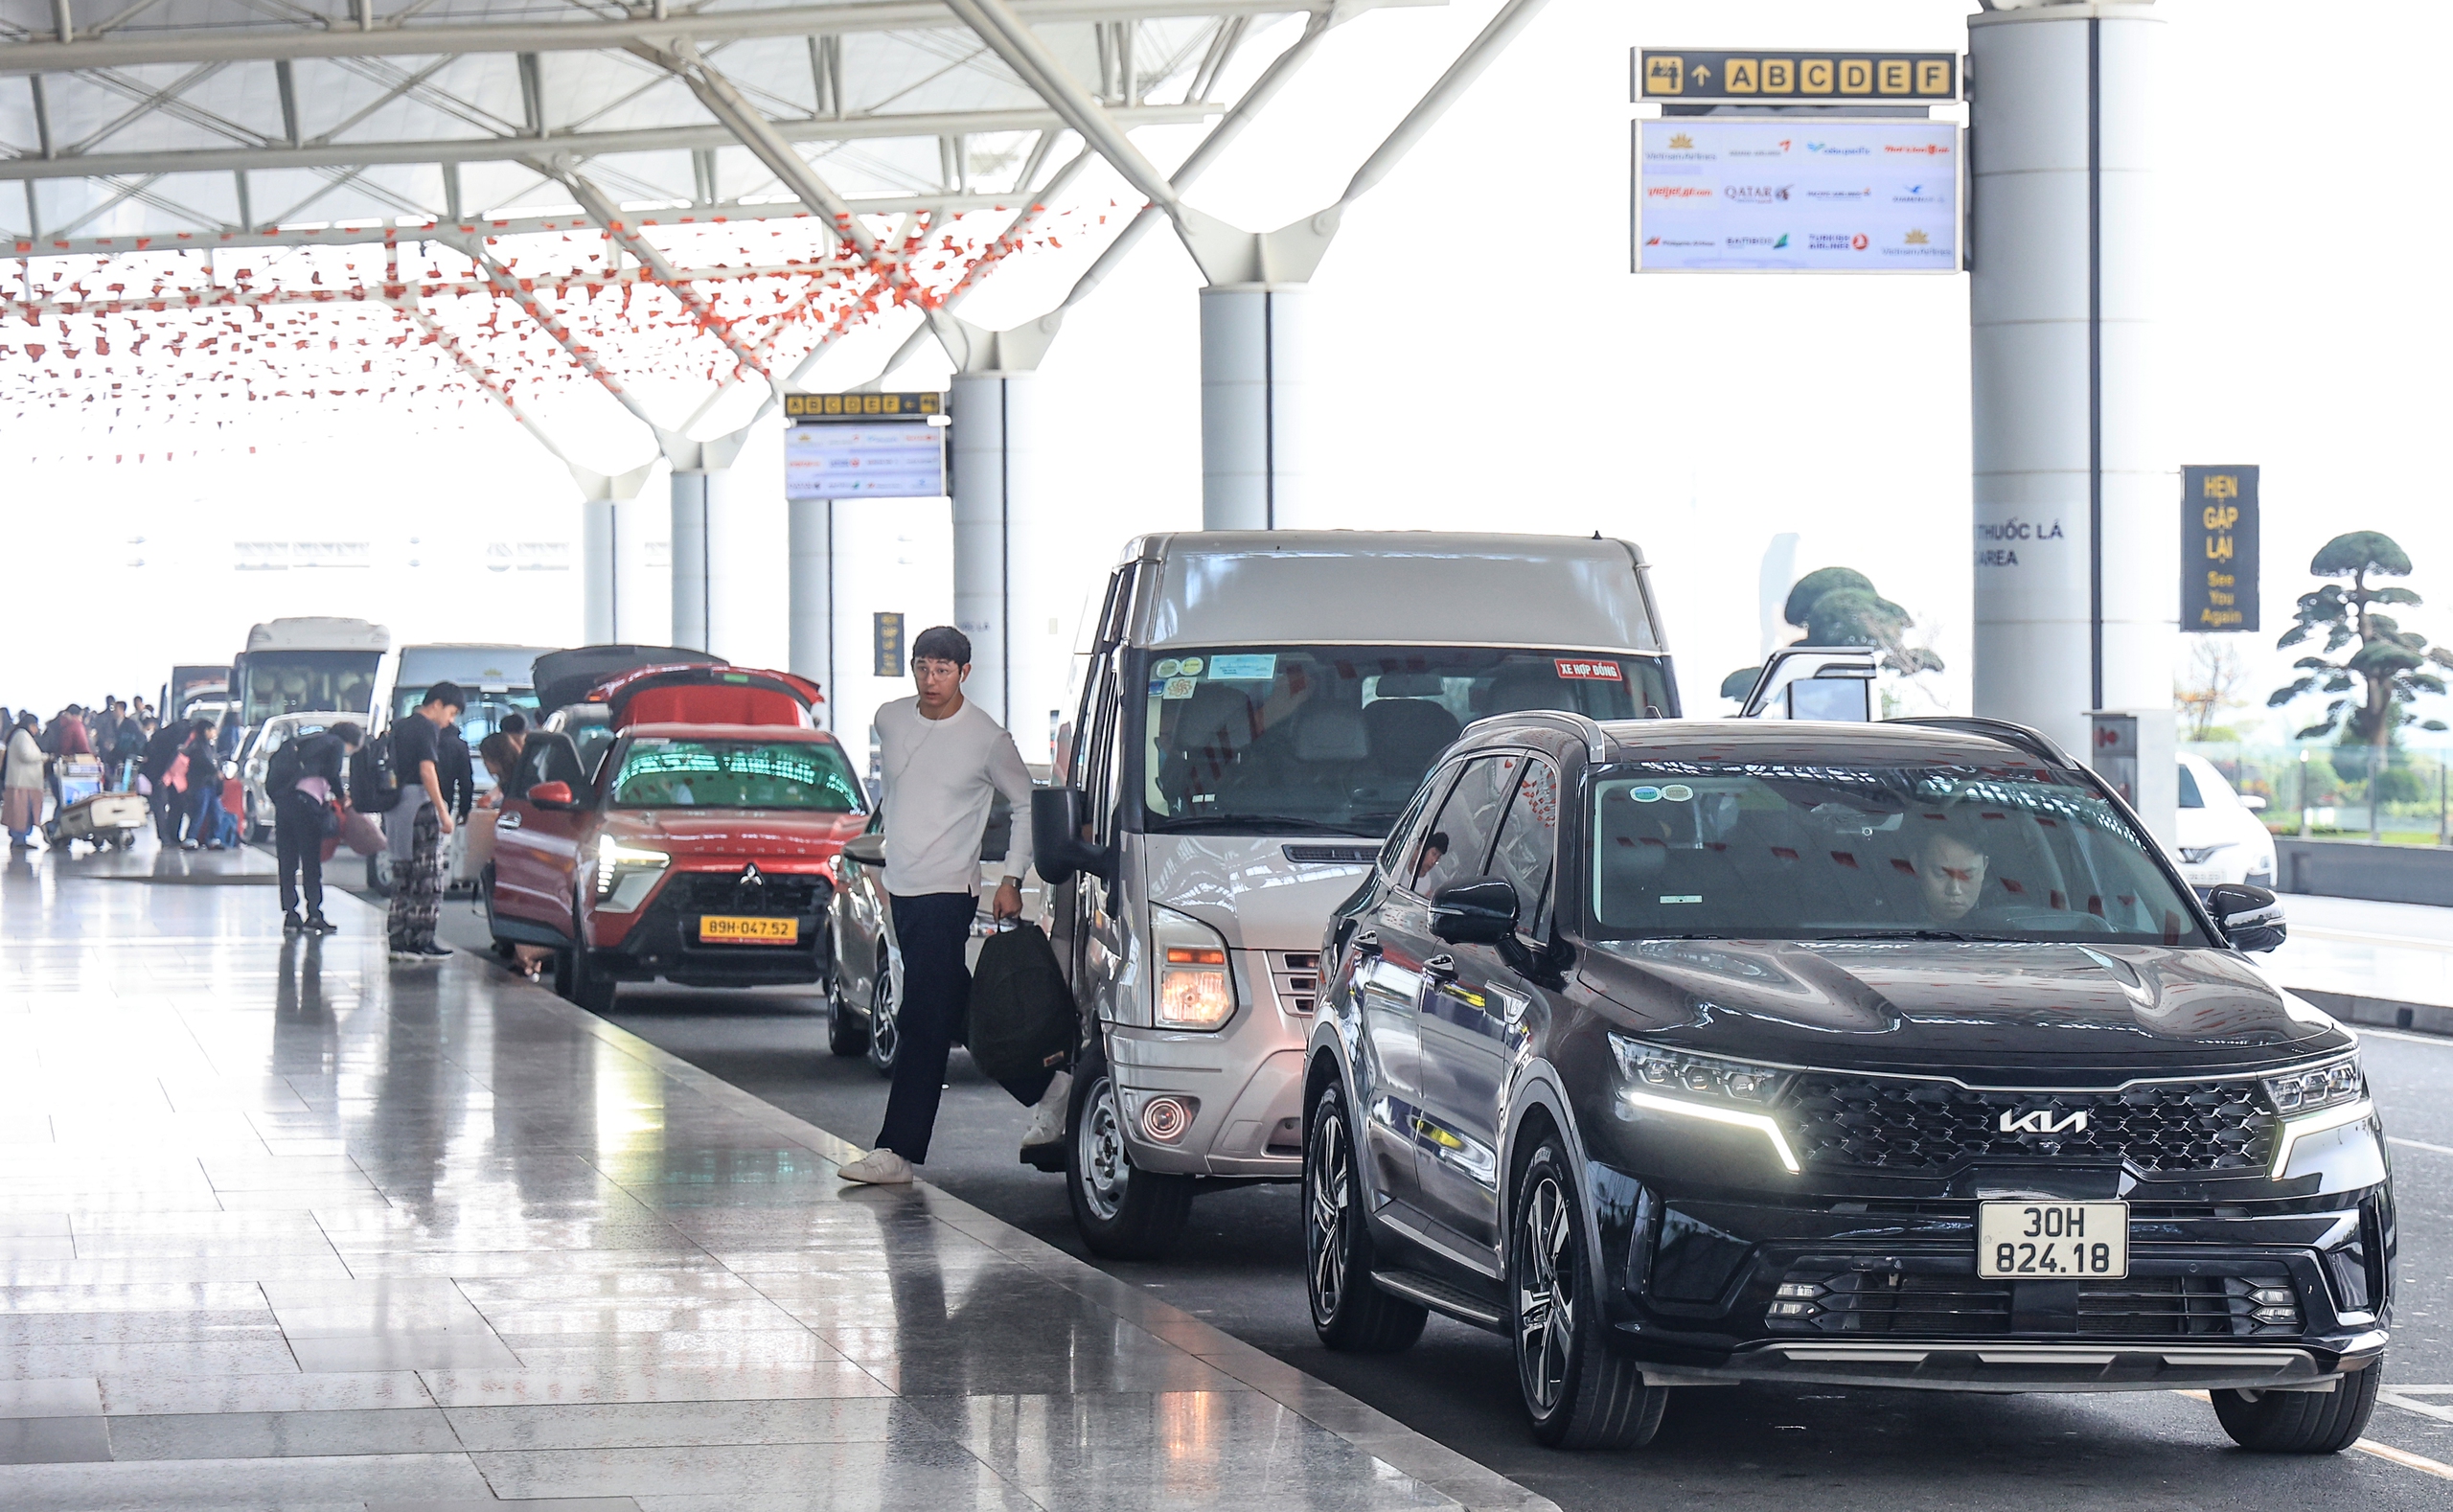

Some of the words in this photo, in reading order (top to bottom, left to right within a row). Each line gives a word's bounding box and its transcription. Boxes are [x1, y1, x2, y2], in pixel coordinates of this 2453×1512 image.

[1731, 65, 1752, 87] A
[1768, 65, 1786, 86] B
[1808, 65, 1826, 87] C
[1847, 66, 1866, 87] D
[1887, 66, 1904, 87] E
[1926, 66, 1942, 88] F
[1725, 185, 1773, 200] QATAR
[2207, 570, 2235, 587] See
[2208, 589, 2235, 606] You
[2200, 607, 2243, 628] Again
[1560, 663, 1573, 676] XE
[2023, 1206, 2085, 1238] 30H
[1996, 1242, 2110, 1273] 824.18
